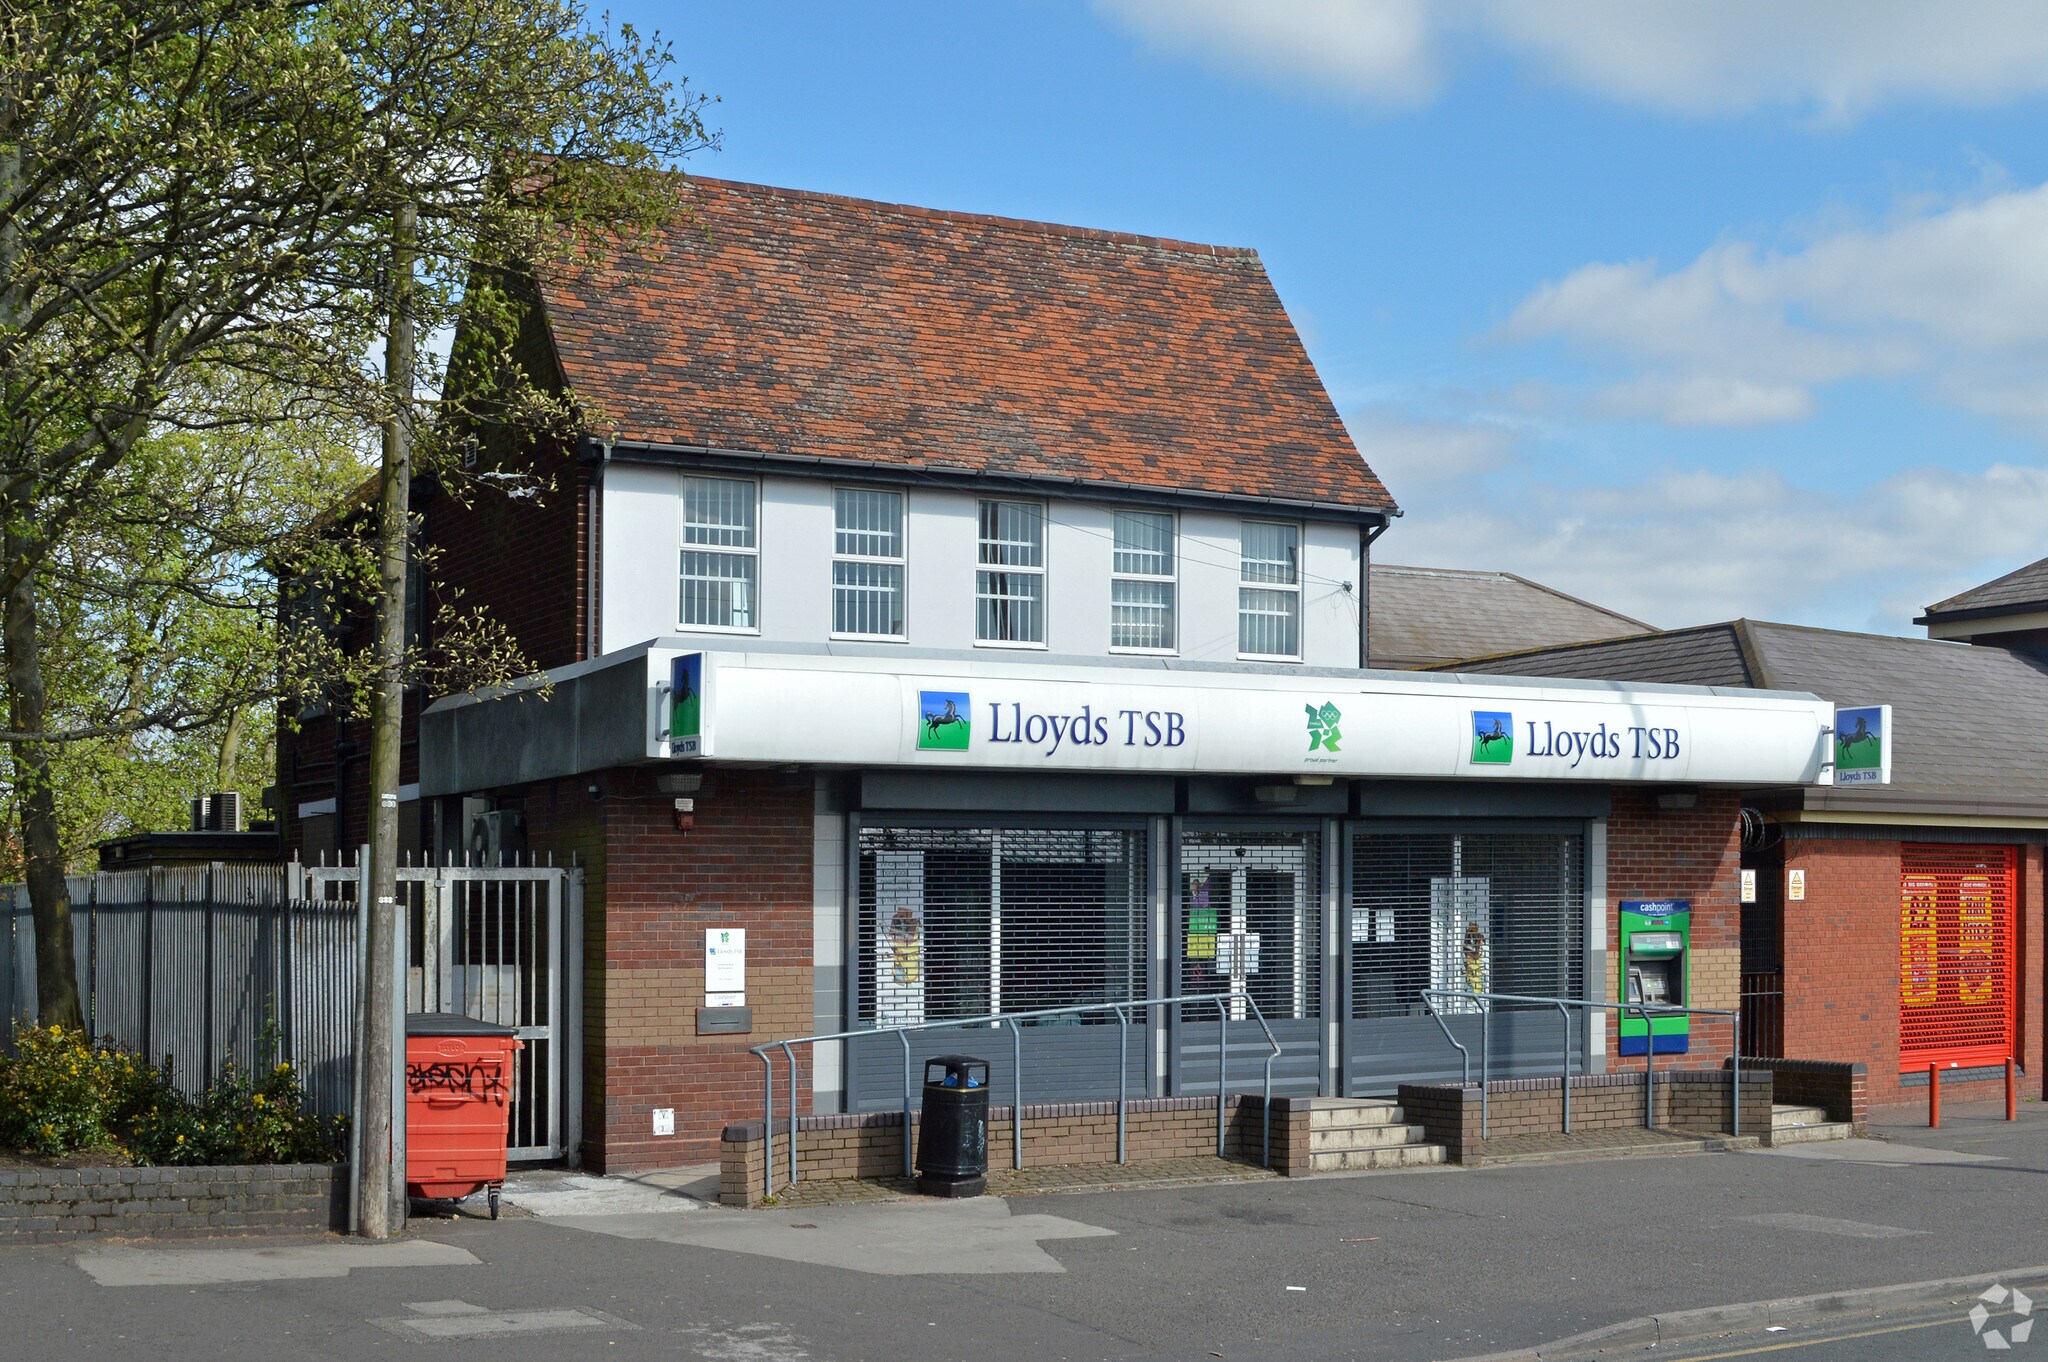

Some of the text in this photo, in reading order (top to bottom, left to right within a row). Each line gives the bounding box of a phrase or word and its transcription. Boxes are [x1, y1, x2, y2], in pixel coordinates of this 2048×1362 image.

[988, 702, 1186, 757] Lloyds TSB
[671, 739, 697, 756] Lloyds TSB
[1526, 720, 1681, 768] Lloyds TSB
[1839, 771, 1877, 783] Lloyds TSB
[1640, 902, 1674, 914] cashpoint
